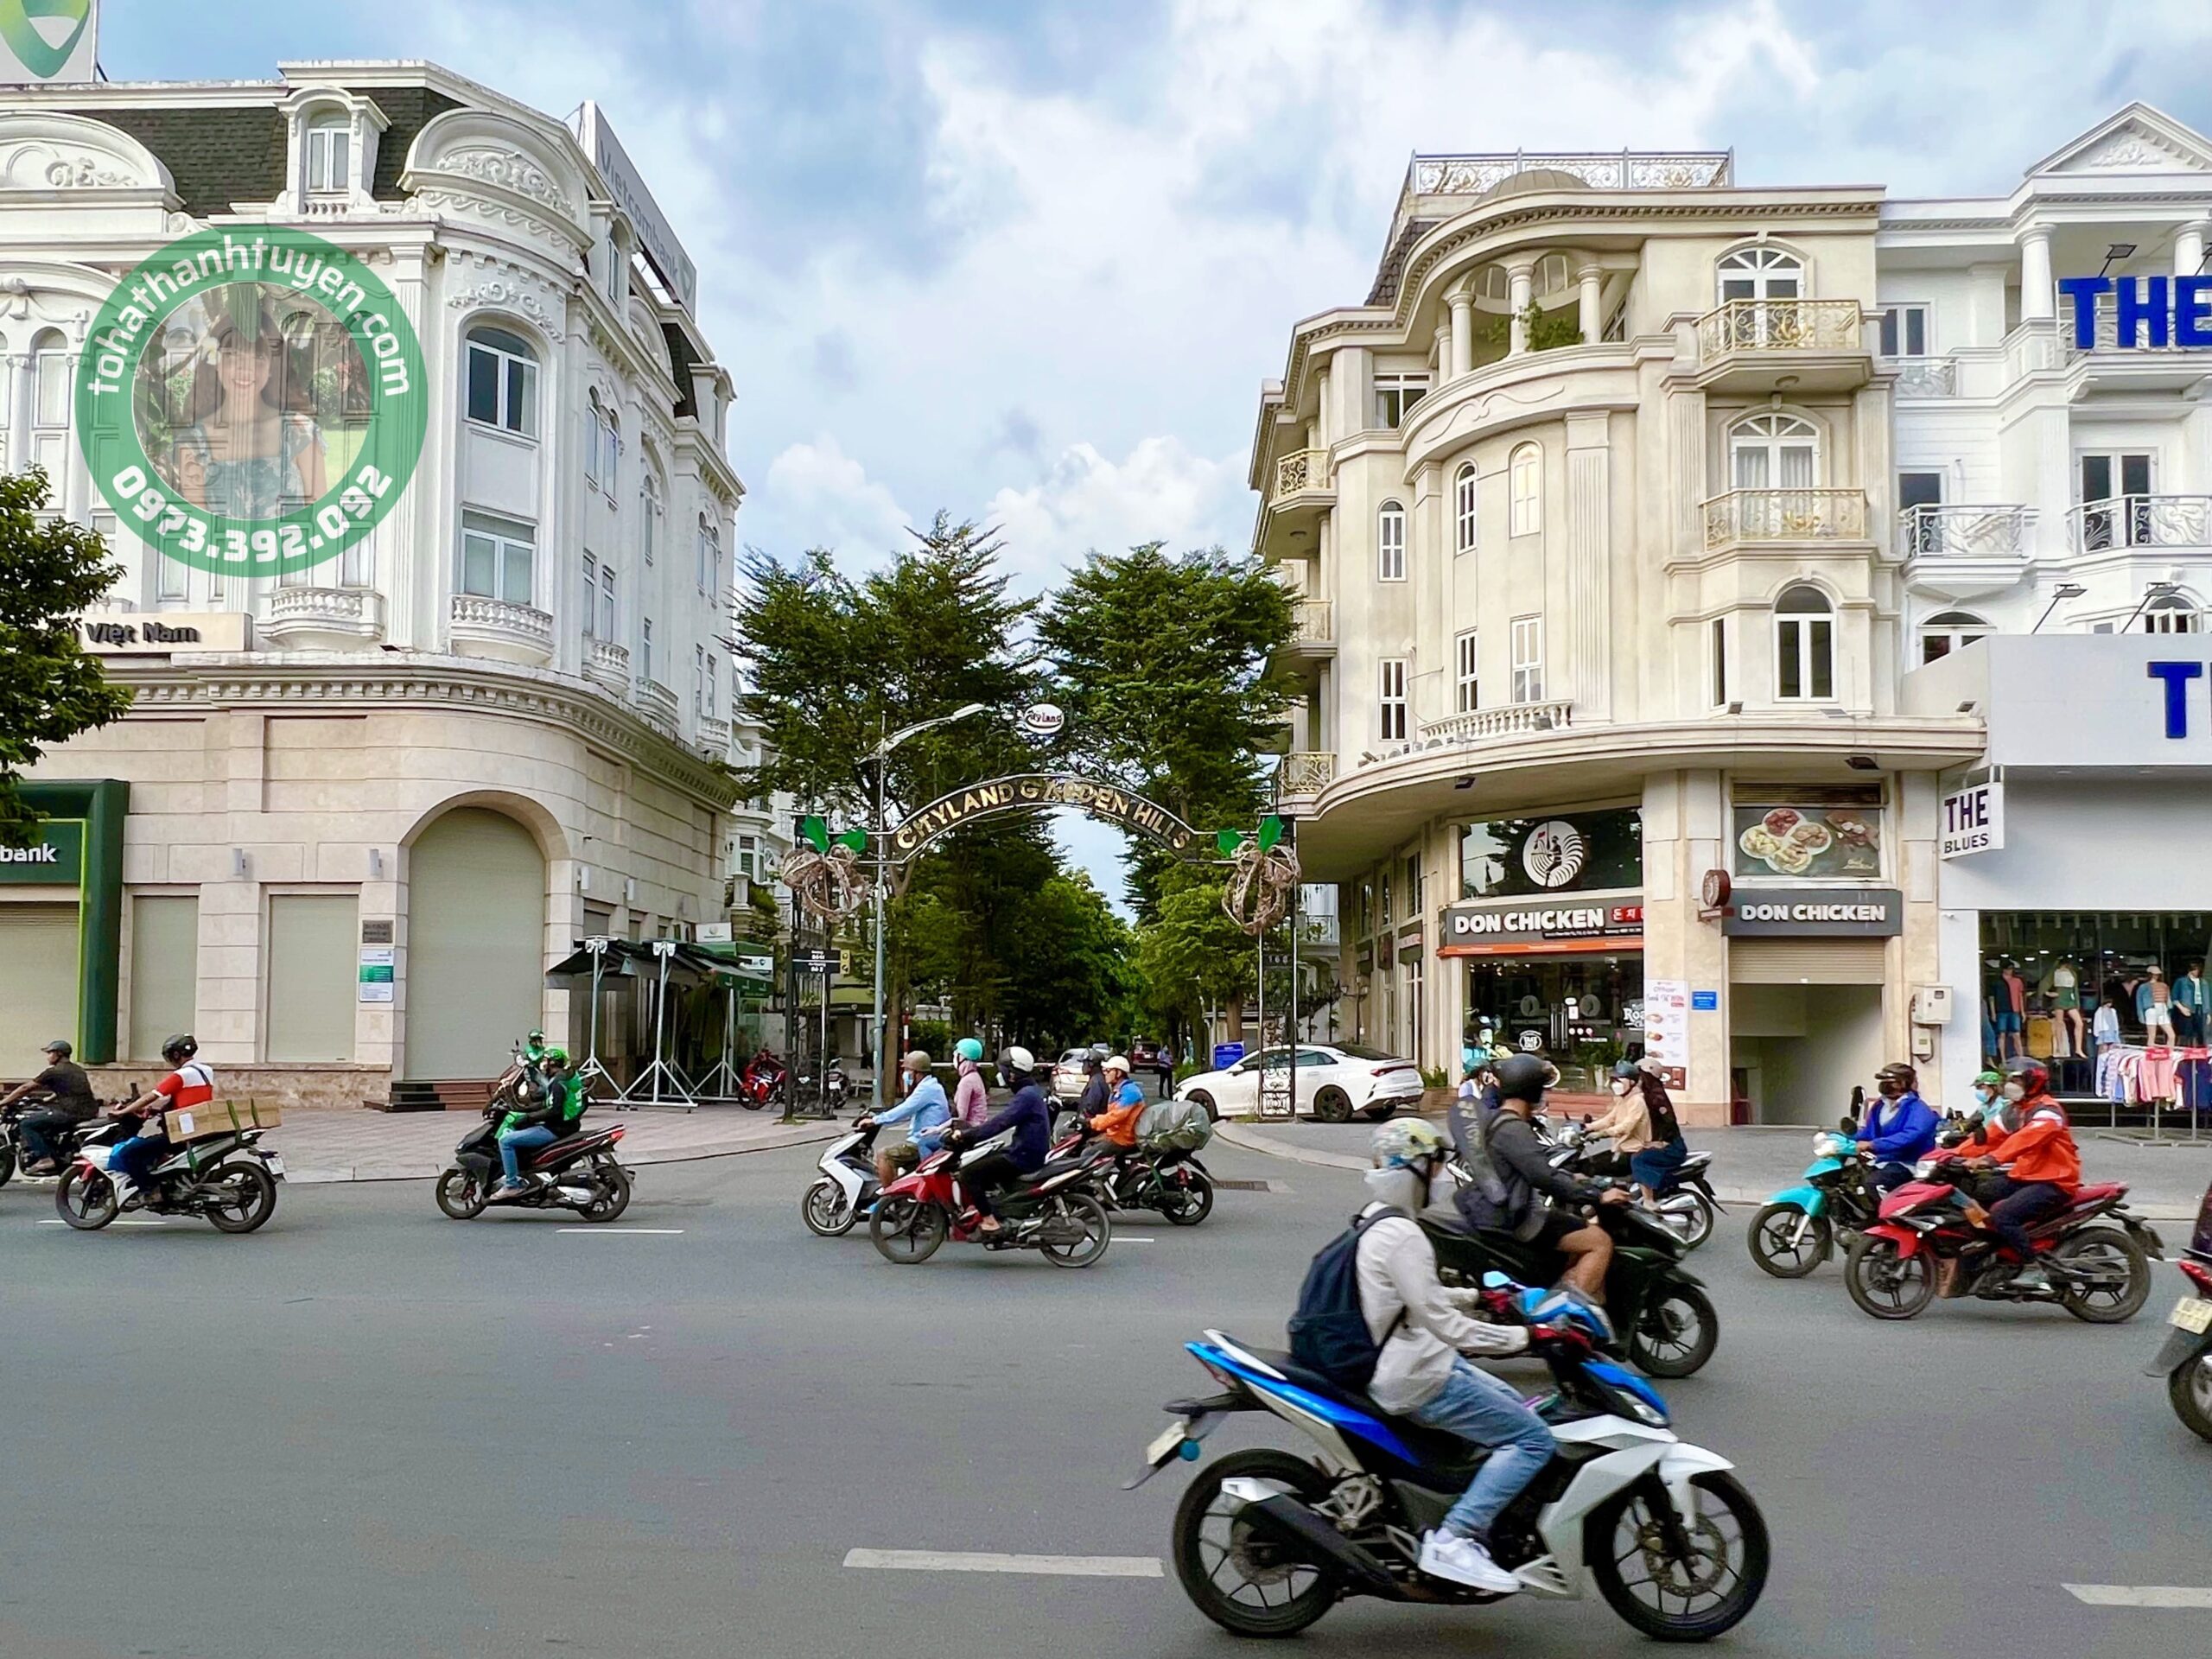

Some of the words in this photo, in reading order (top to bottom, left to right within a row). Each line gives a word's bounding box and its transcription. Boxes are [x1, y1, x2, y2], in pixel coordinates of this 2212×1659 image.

[2059, 276, 2212, 349] THE
[143, 622, 200, 643] Nam
[896, 782, 1015, 849] CITYLAND
[1134, 802, 1191, 849] HILLS
[1944, 789, 1989, 833] THE
[0, 842, 57, 862] bank
[1944, 833, 1989, 854] BLUES
[1454, 914, 1501, 934] DON
[1503, 908, 1605, 931] CHICKEN
[1741, 905, 1789, 921] DON
[1792, 904, 1885, 922] CHICKEN
